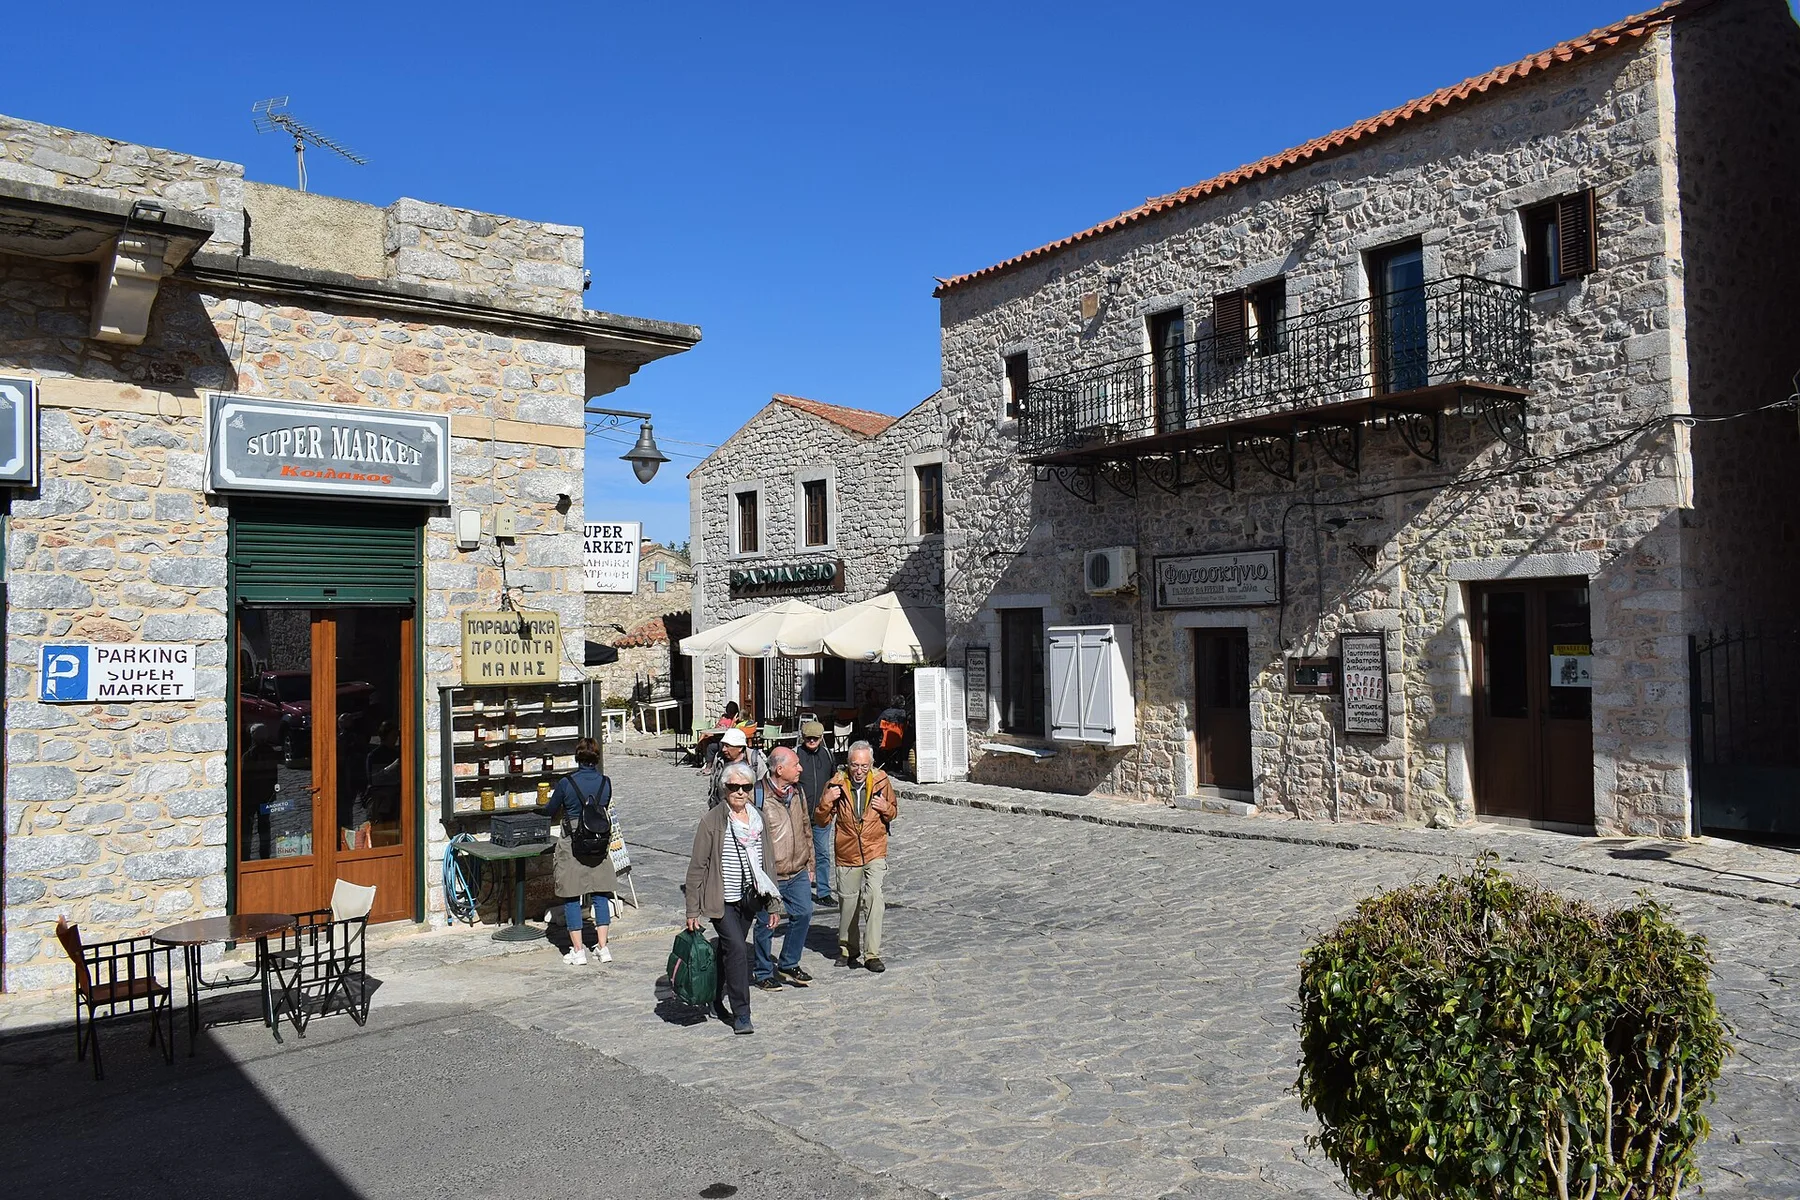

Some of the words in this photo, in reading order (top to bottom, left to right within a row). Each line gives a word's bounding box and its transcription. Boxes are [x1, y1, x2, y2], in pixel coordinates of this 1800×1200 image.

[246, 425, 325, 459] SUPER
[331, 425, 424, 466] MARKET
[583, 525, 623, 538] UPER
[583, 541, 634, 554] ARKET
[583, 559, 630, 567] ΛΗΝΙΚΗ
[583, 569, 630, 579] ΑΤΡΟΦΗ
[1164, 557, 1269, 586] Φωτοσκήνιο
[467, 619, 555, 635] ΠΑΡΑΔΟΑΚΑ
[471, 638, 553, 655] ΠΡΟΪΟΝΤΑ
[97, 649, 188, 663] PARKING
[107, 669, 174, 681] SUPER
[482, 660, 546, 677] ΜΑΝΗΣ
[99, 684, 184, 696] MARKET
